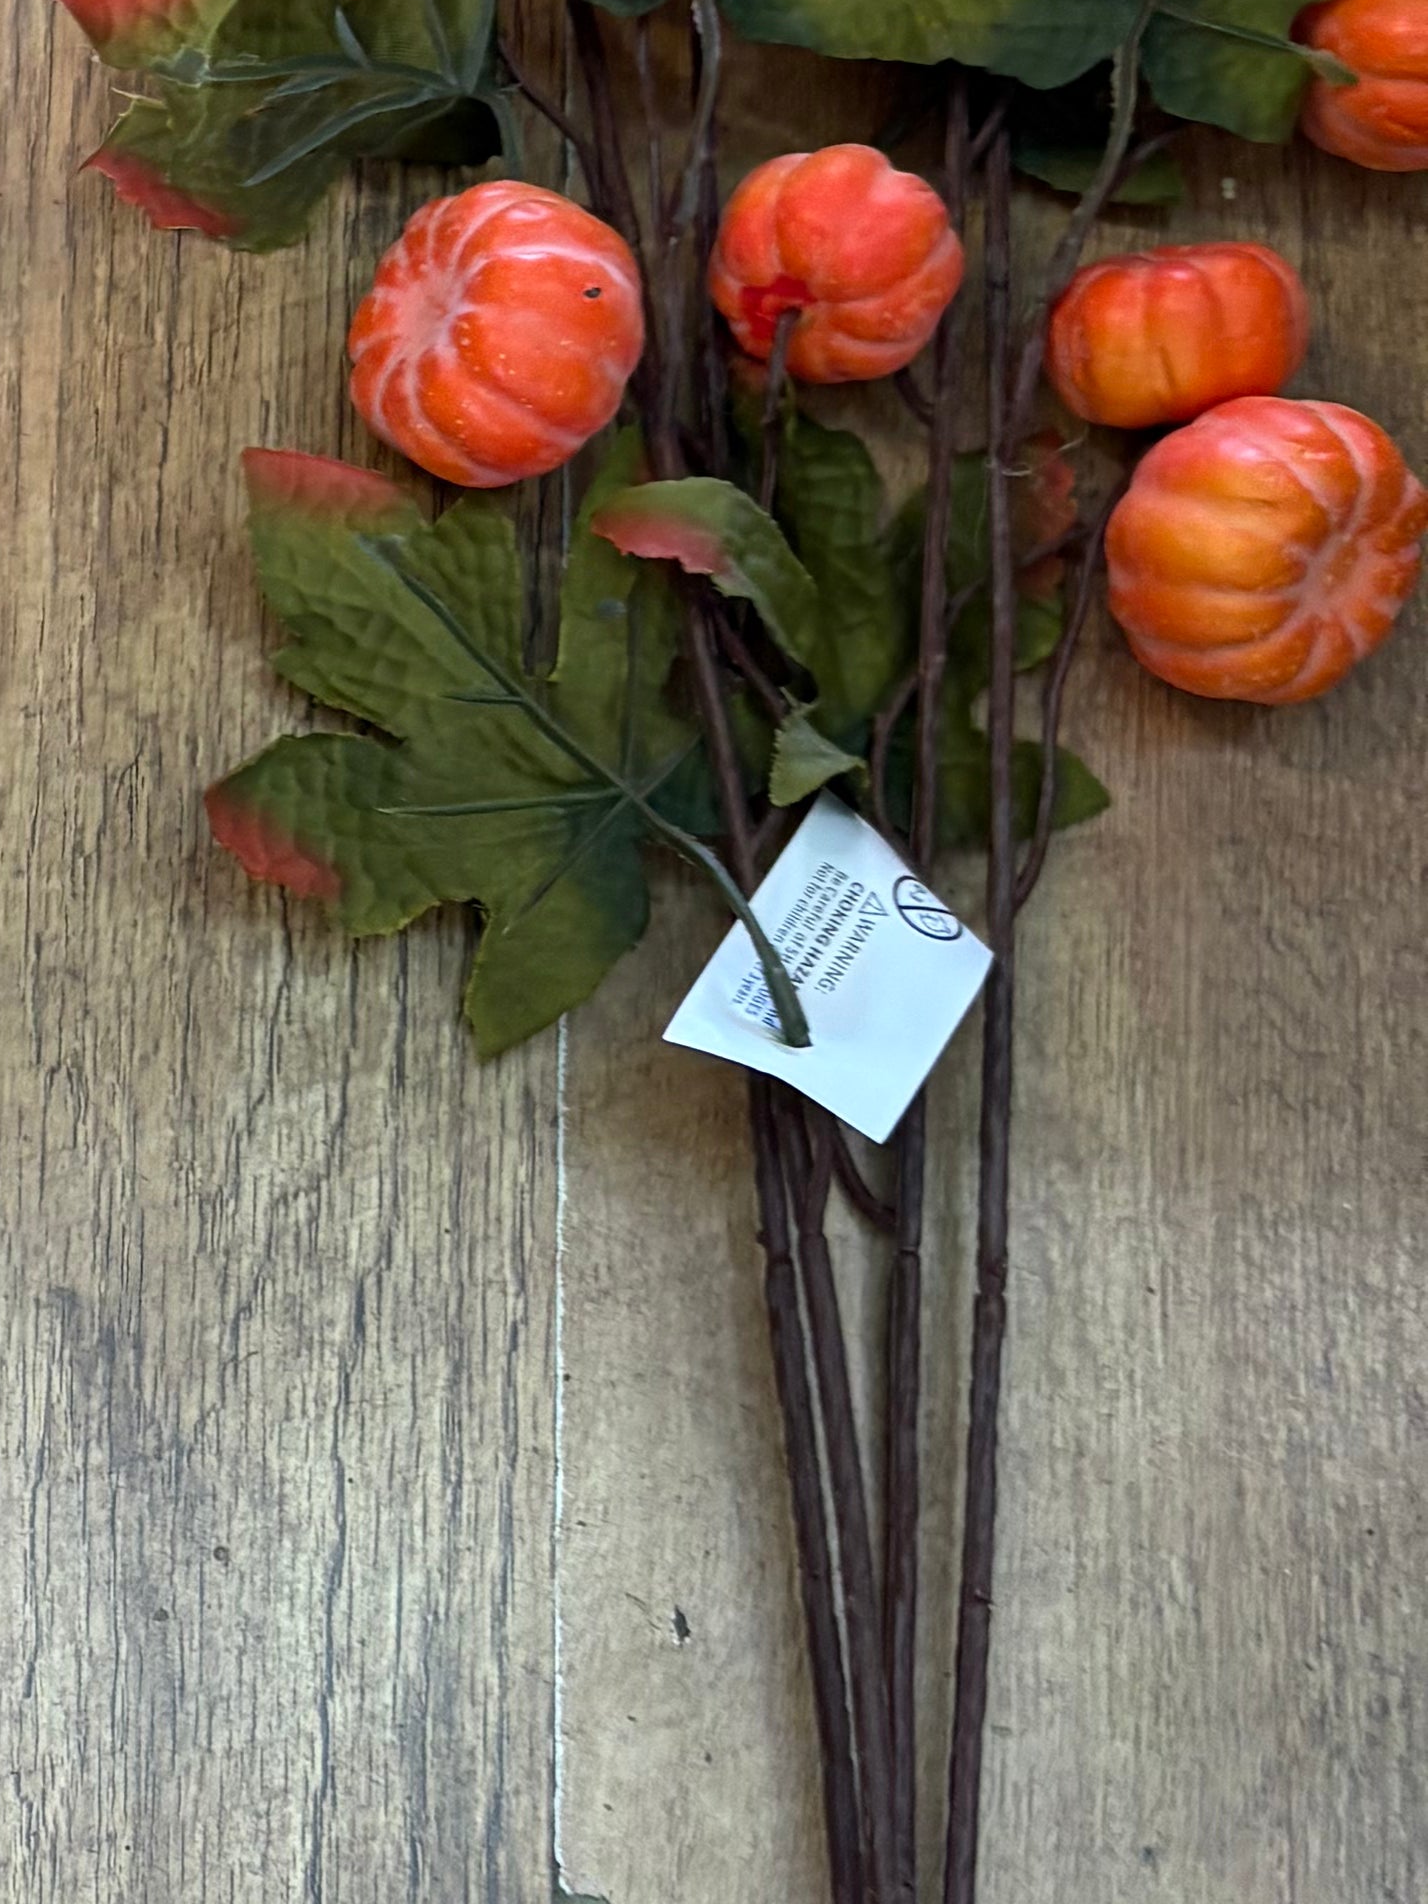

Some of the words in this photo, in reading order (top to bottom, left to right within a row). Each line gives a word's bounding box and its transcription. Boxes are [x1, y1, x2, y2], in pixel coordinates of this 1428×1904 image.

[813, 862, 835, 883] Not
[830, 870, 850, 886] Be
[803, 881, 822, 898] for
[773, 899, 808, 943] children
[802, 886, 837, 931] Careful
[815, 882, 865, 947] CHOKING
[792, 933, 806, 949] of
[814, 918, 876, 995] WARNING:
